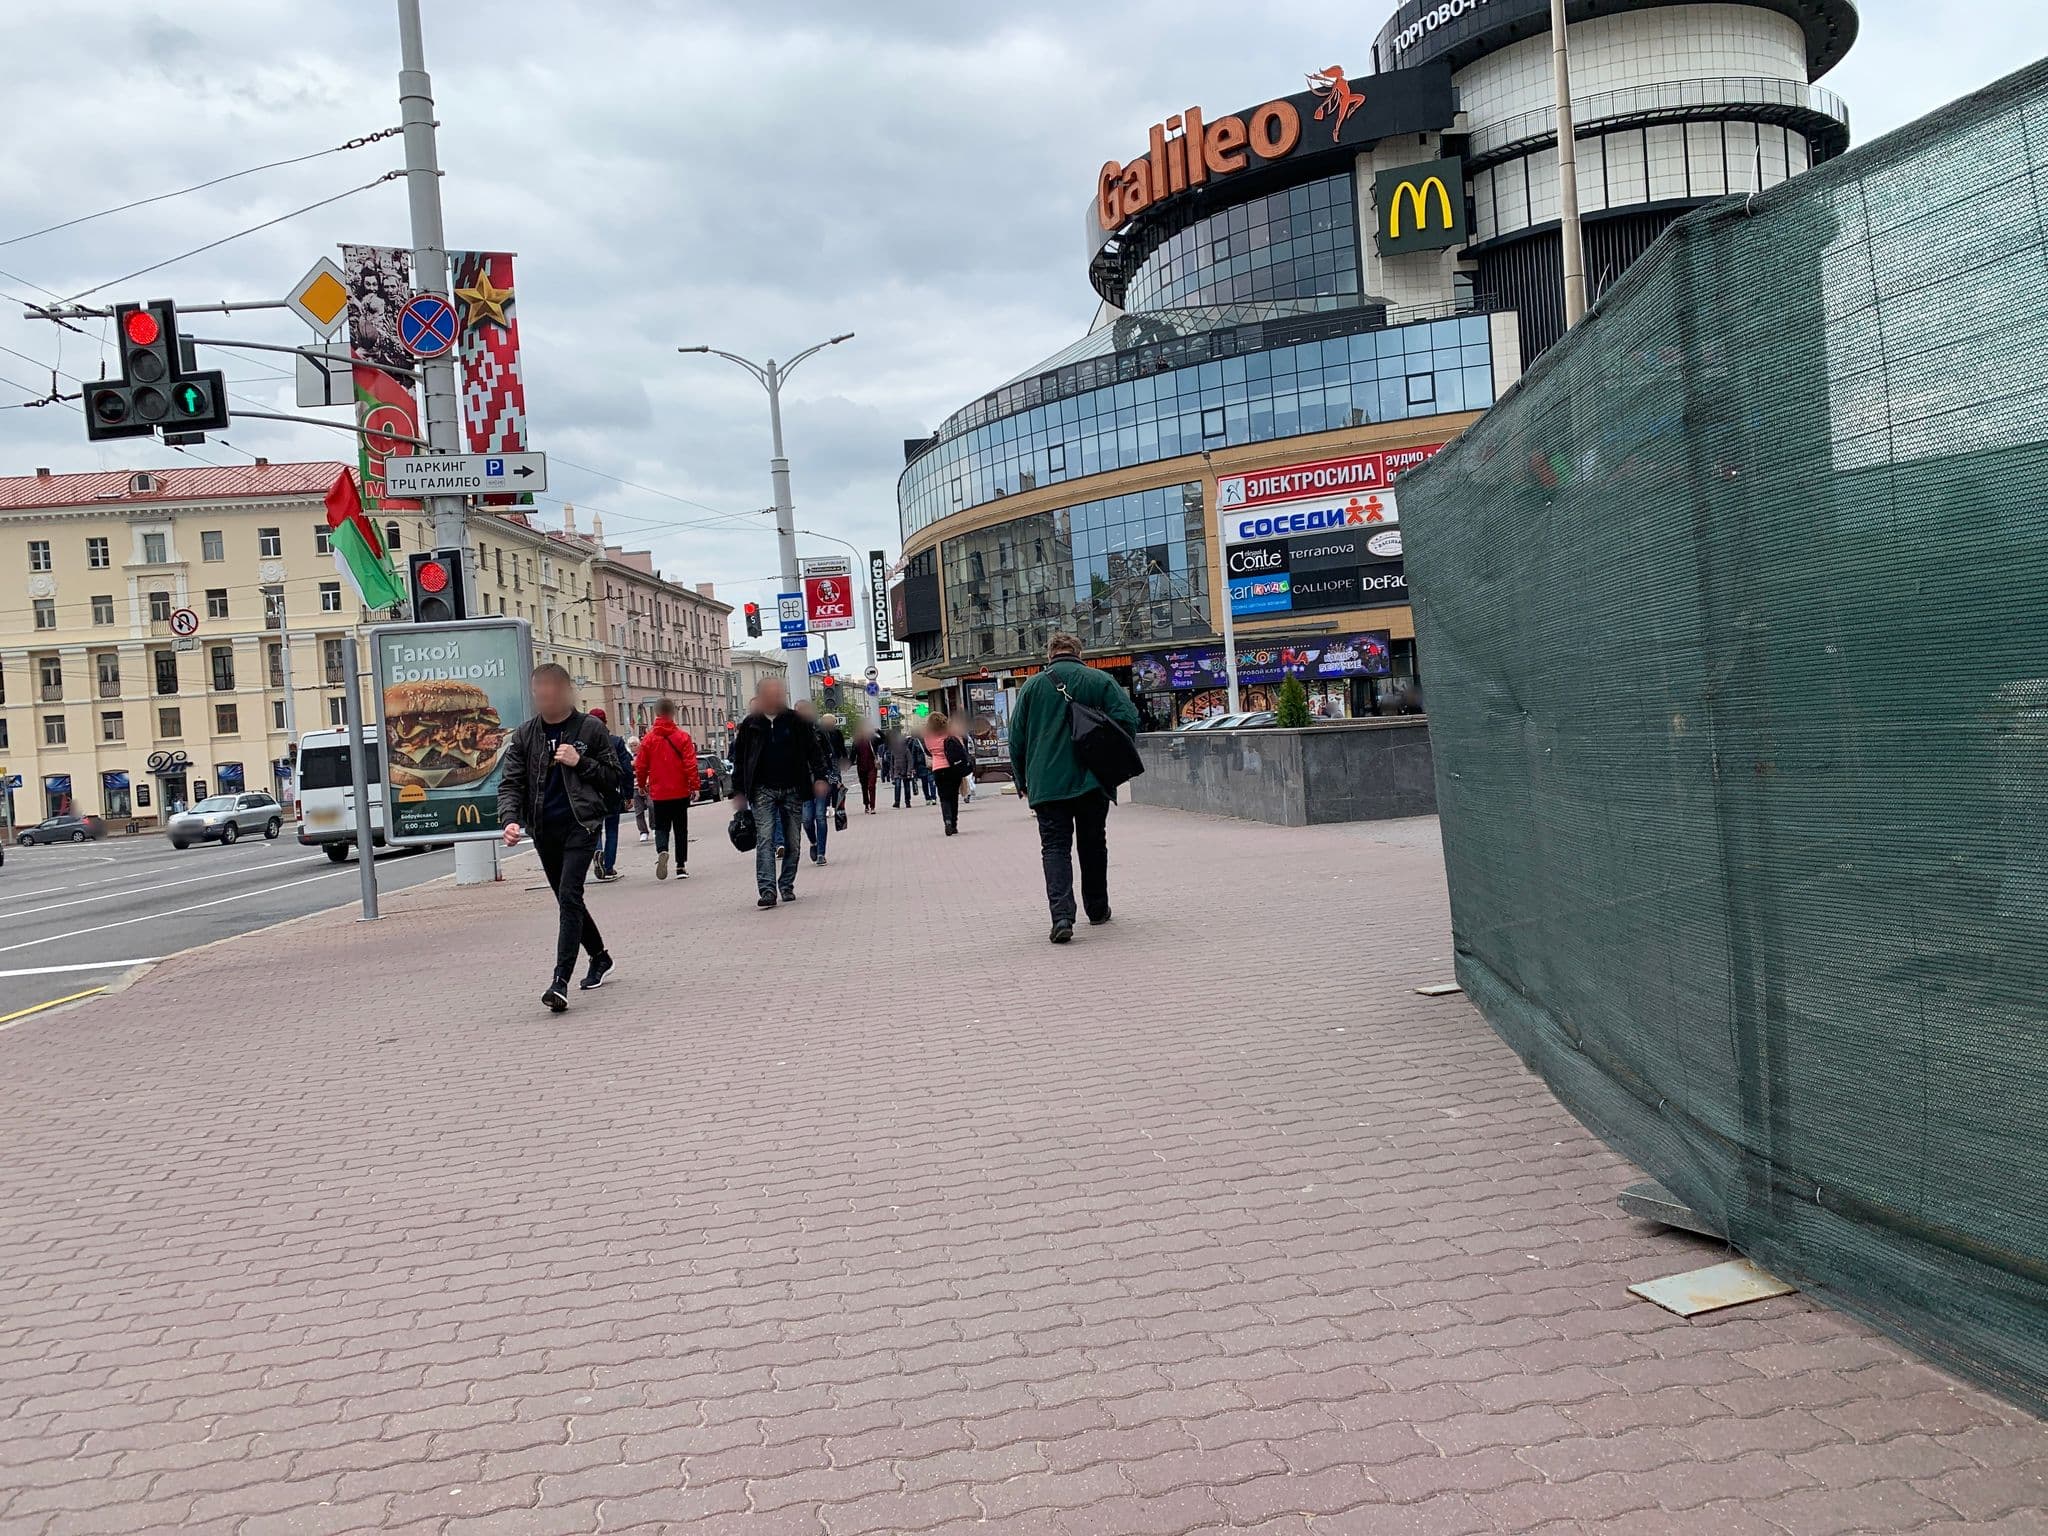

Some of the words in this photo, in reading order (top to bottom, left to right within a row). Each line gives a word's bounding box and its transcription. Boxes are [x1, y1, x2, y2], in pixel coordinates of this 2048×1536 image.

[1098, 99, 1301, 231] Galileo
[405, 461, 467, 474] ПАРКИНГ
[1247, 463, 1376, 498] ЭЛЕКТРОСИЛА
[1385, 451, 1425, 467] аудио
[390, 478, 417, 491] ТРЦ
[420, 476, 481, 490] ГАЛИЛЕО
[1239, 508, 1345, 539] СОСЕДИ
[1229, 549, 1283, 573] Conte
[1292, 580, 1352, 595] CALLIOPE
[815, 603, 844, 616] KFC
[872, 558, 888, 643] McDonald's
[388, 641, 461, 664] Такой
[391, 658, 506, 684] Большой!
